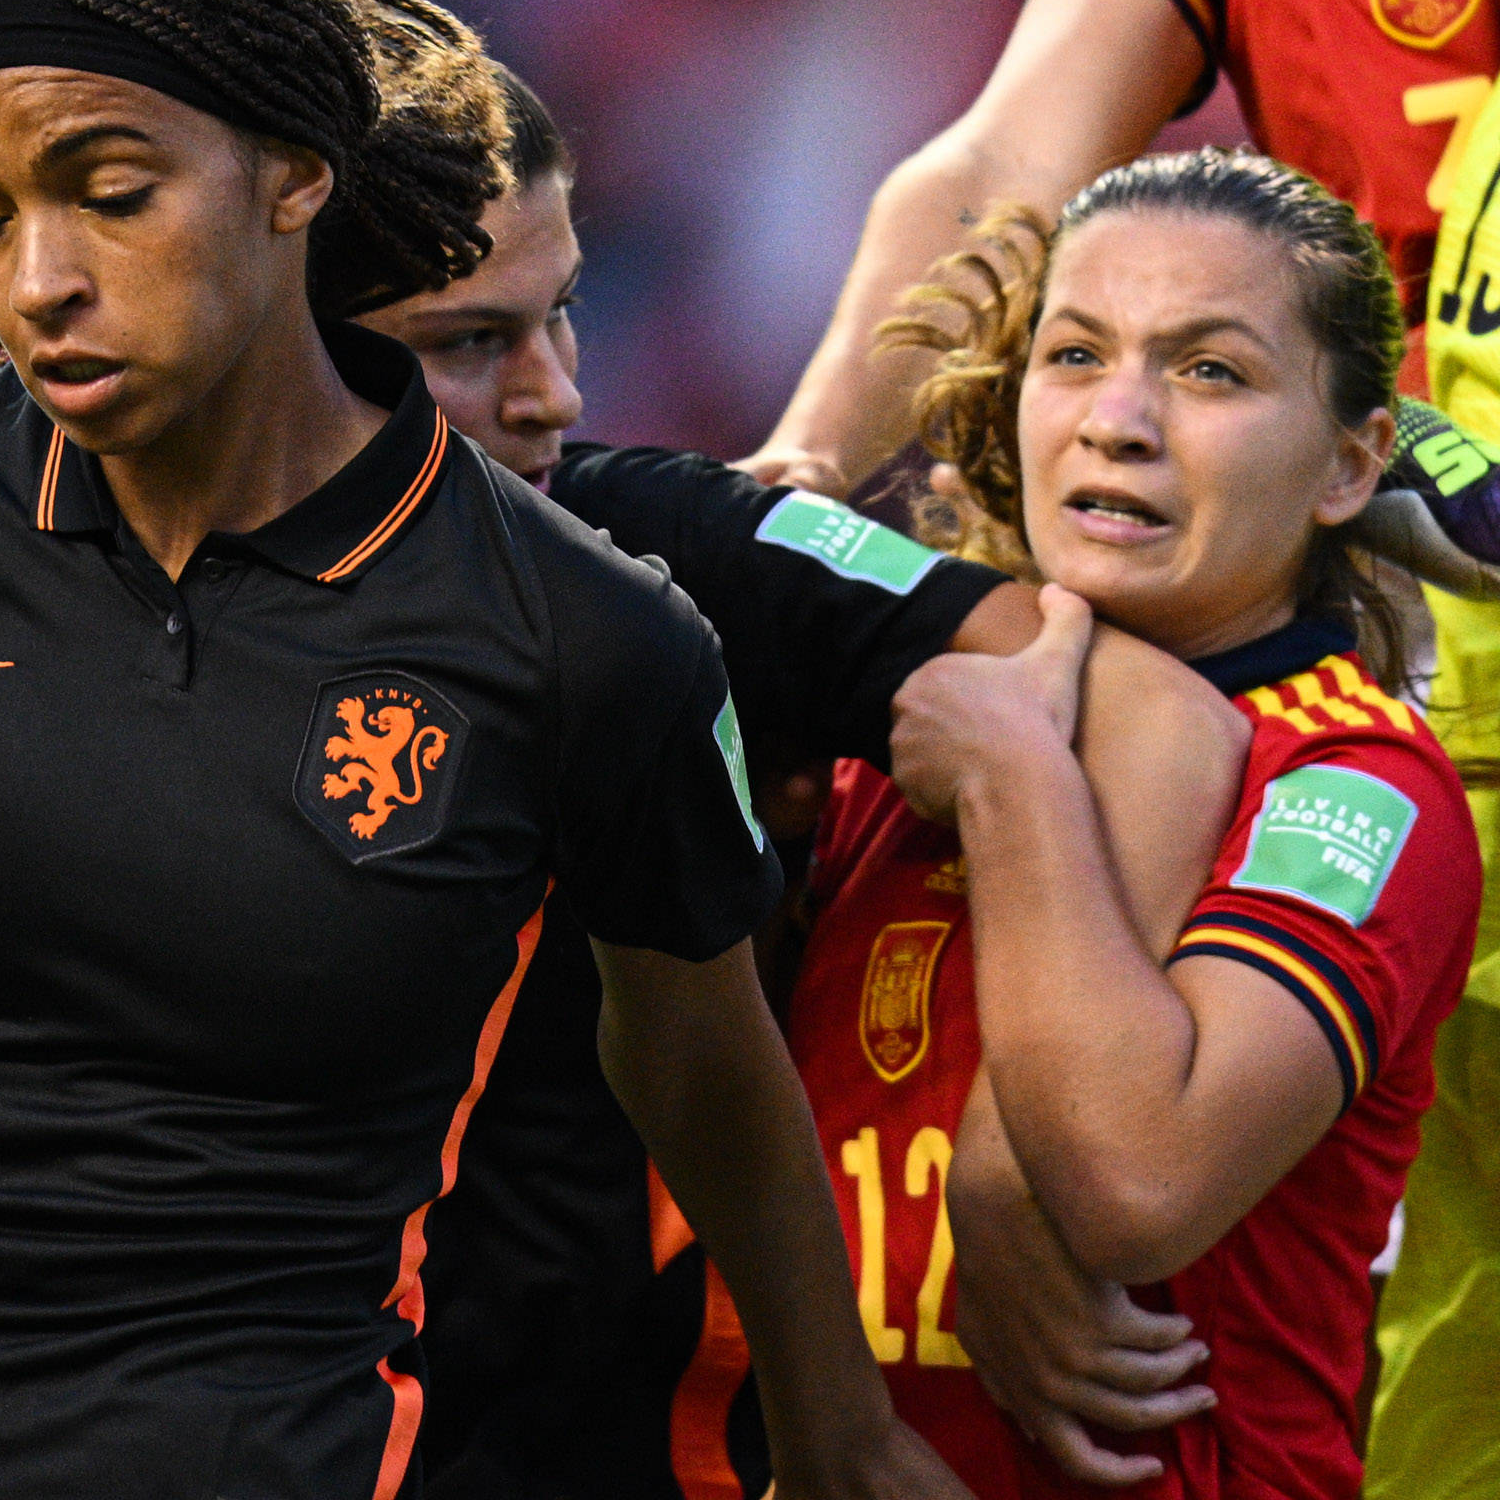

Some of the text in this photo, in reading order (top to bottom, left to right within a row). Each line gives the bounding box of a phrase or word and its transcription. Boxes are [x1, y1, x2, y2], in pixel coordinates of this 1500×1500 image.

[1402, 74, 1494, 213] 7
[374, 687, 423, 709] KNVB
[1268, 809, 1384, 857] FOOTBALL
[1276, 797, 1394, 843] LIVING
[1321, 845, 1375, 886] FIFA
[841, 1126, 974, 1368] 12
